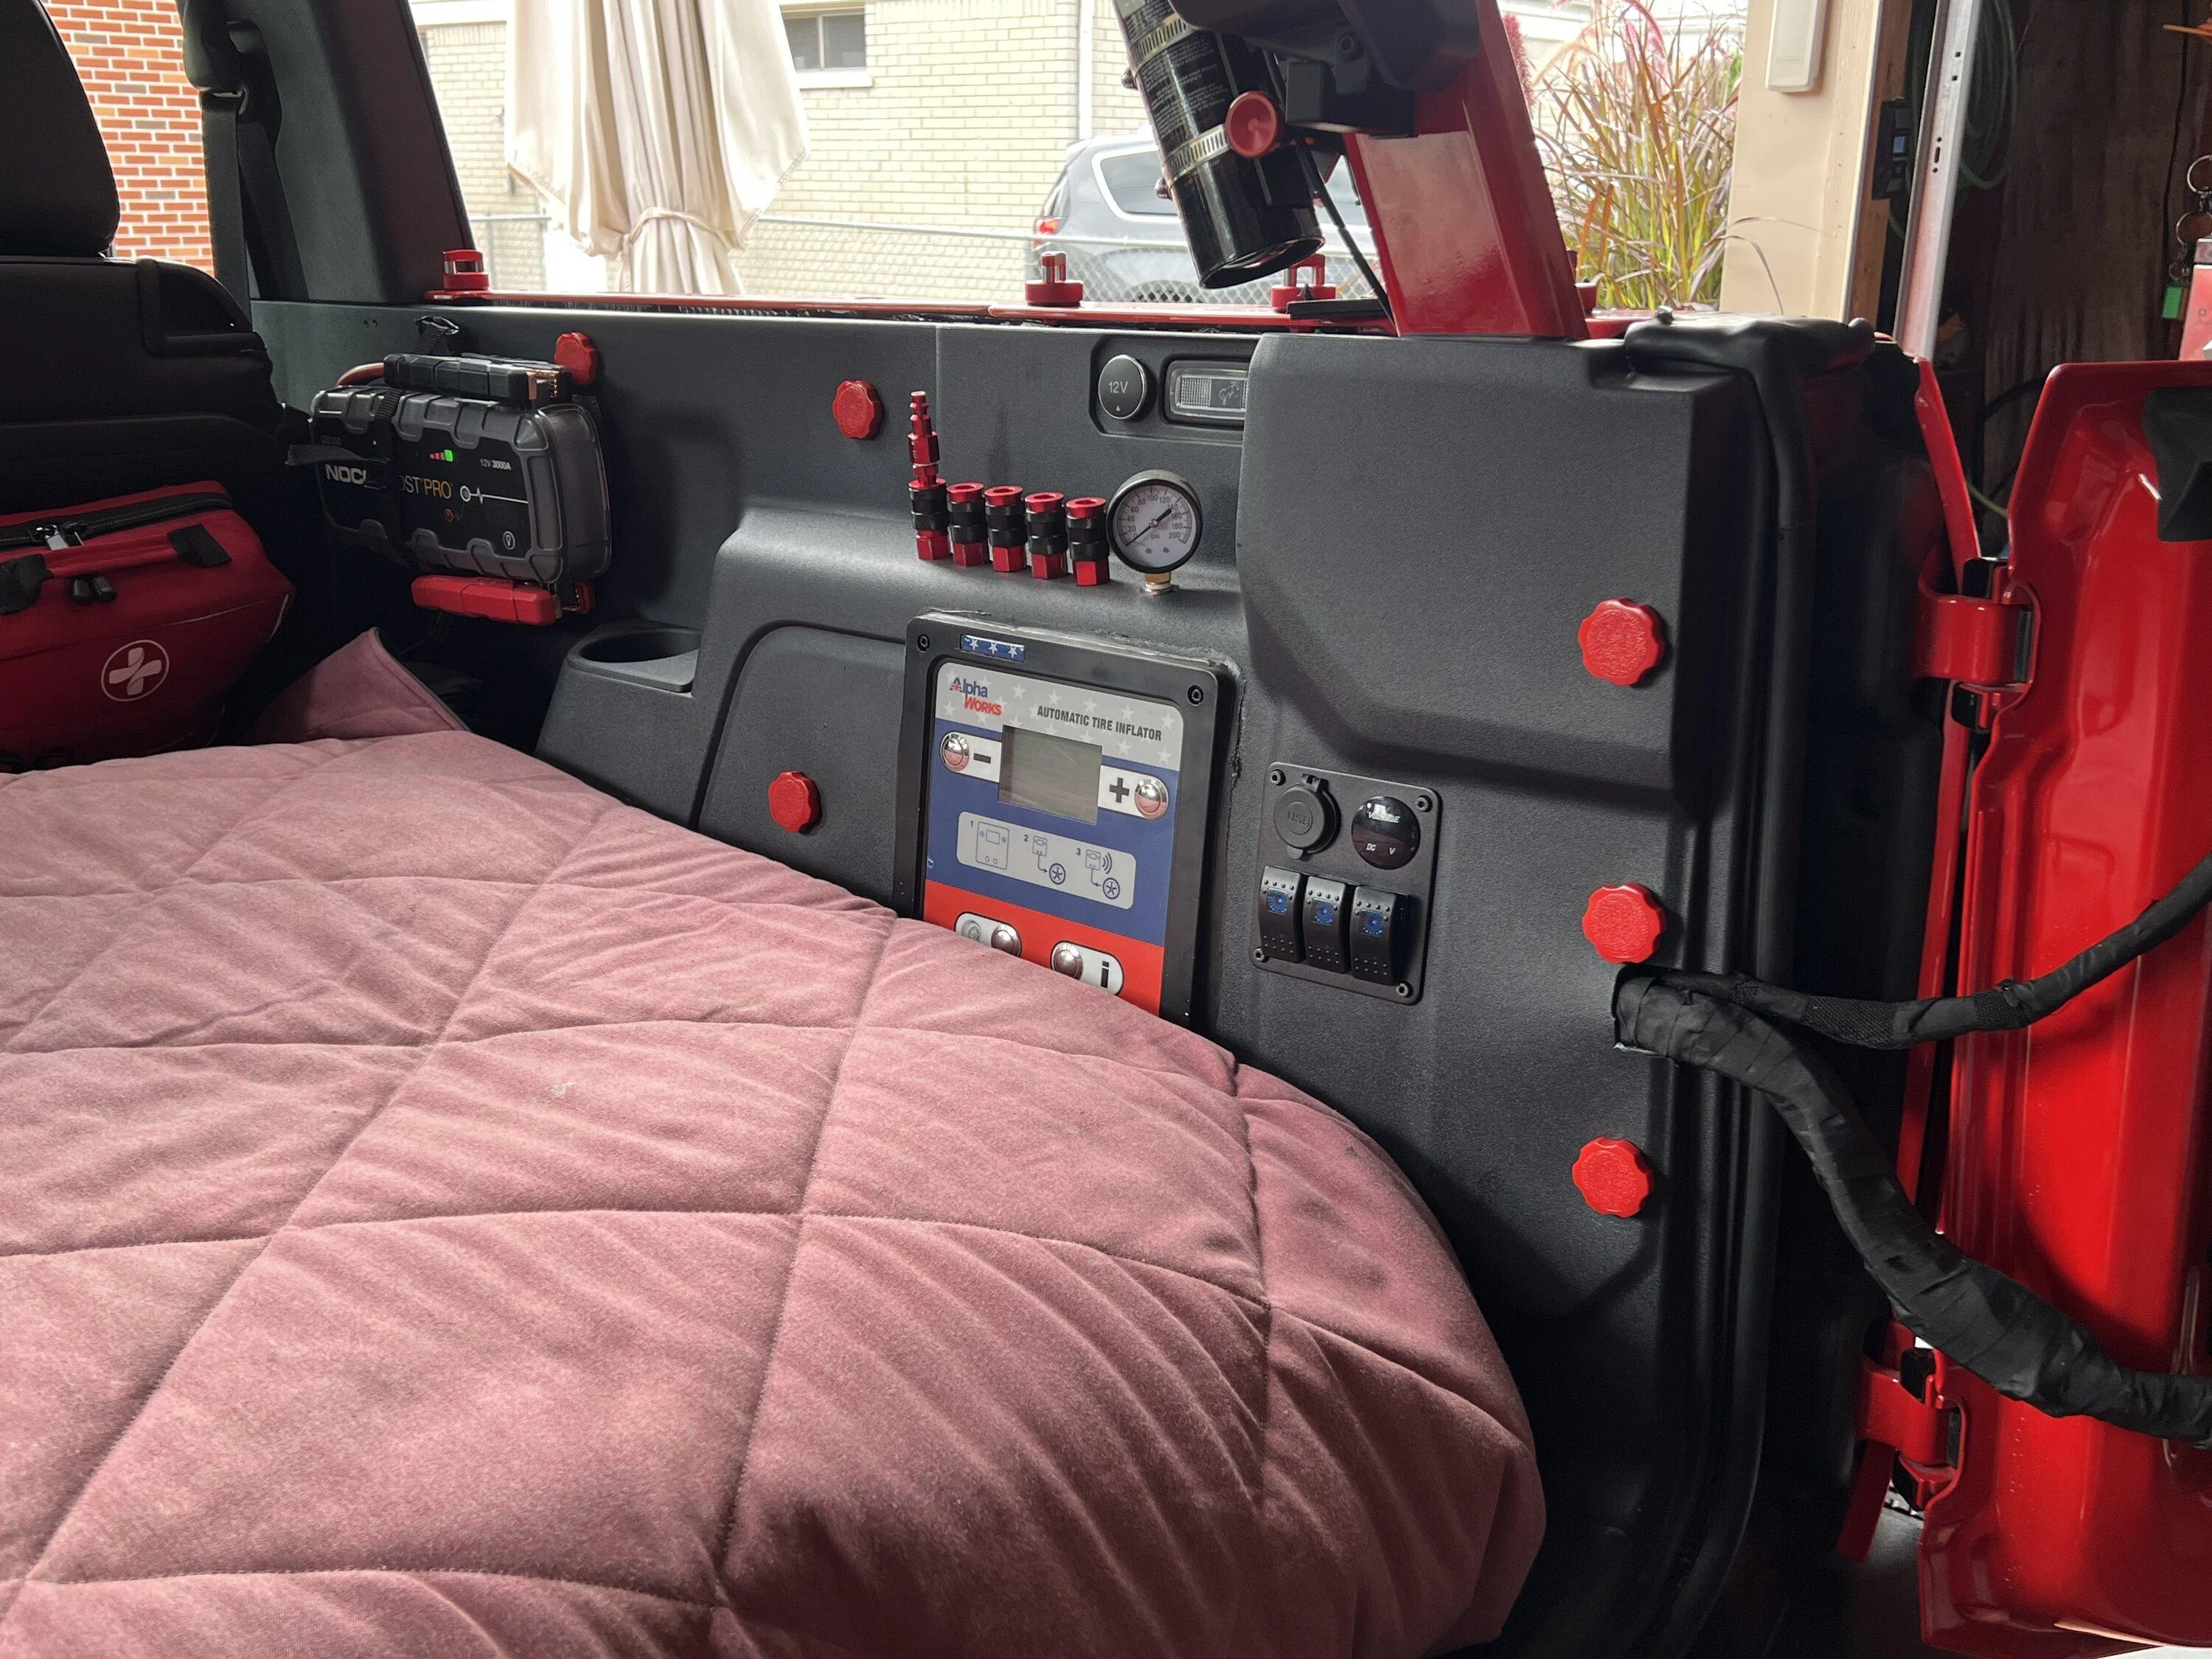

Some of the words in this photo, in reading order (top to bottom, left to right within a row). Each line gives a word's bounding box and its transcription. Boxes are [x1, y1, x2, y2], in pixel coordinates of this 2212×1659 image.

[1108, 380, 1128, 394] 12V
[480, 459, 491, 467] 12V
[492, 460, 511, 470] 3000A
[324, 463, 367, 485] NOC
[424, 479, 452, 499] PRO
[949, 677, 988, 700] Alpha
[964, 697, 1002, 716] WORKS
[1037, 706, 1089, 727] AUTOMATIC
[1092, 716, 1113, 731] TIRE
[1116, 720, 1162, 742] INFLATOR
[1023, 835, 1029, 843] 2
[1077, 848, 1081, 856] 3
[1366, 843, 1376, 852] DC
[1388, 847, 1397, 855] V
